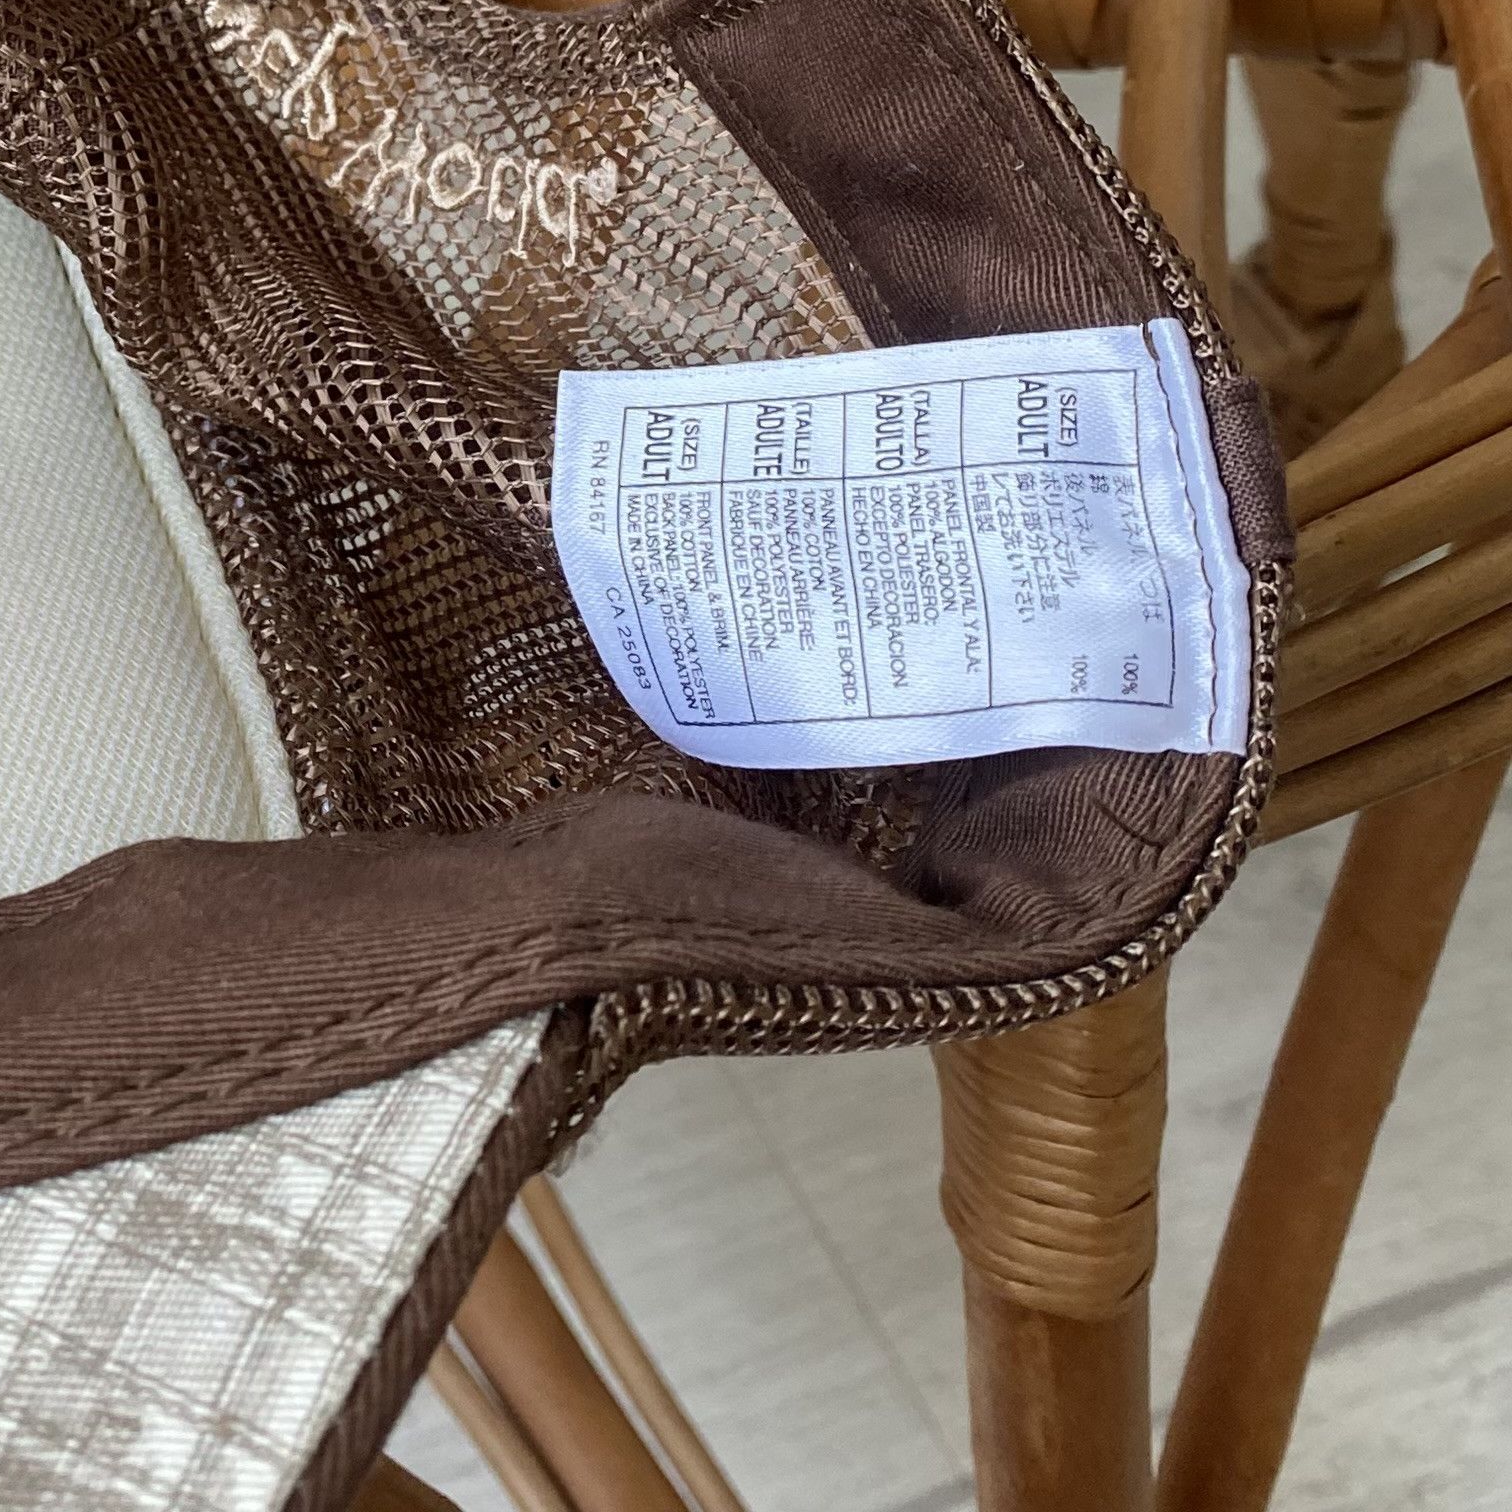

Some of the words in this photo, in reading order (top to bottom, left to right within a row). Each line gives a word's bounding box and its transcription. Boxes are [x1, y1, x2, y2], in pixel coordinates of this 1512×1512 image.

[642, 410, 674, 482] ADULT
[676, 418, 702, 471] (SIZE)
[754, 404, 785, 477] ADULTE
[790, 402, 812, 475] (TAILLE)
[875, 393, 904, 471] ADULTO
[911, 390, 932, 466] (TALLA)
[1018, 379, 1048, 457] ADULT
[1056, 388, 1078, 446] (SIZE)
[590, 440, 610, 469] RN
[589, 477, 607, 536] 84167
[627, 494, 642, 533] MADE
[661, 492, 677, 530] BACK
[679, 491, 694, 527] 100%
[695, 491, 712, 541] FRONT
[728, 490, 748, 571] FABRIQUE
[746, 489, 763, 532] SAUF
[764, 490, 781, 529] 100%
[783, 489, 803, 564] PANNEAU
[801, 489, 818, 529] 100%
[820, 488, 841, 562] PANNEAU
[851, 487, 871, 546] HECHO
[869, 486, 893, 565] EXCEPTO
[888, 485, 906, 528] 100%
[906, 483, 926, 539] PANEL
[923, 481, 941, 527] 100%
[941, 479, 963, 536] PANEL
[968, 473, 997, 535] 中国製
[630, 536, 645, 553] IN
[644, 493, 664, 574] EXCLUSIVE
[664, 531, 681, 581] PANEL:
[680, 531, 702, 594] COTTON
[804, 533, 827, 591] COTON
[858, 550, 874, 573] EN
[631, 555, 655, 606] CHINA
[655, 576, 669, 602] OF
[701, 541, 719, 592] PANEL
[736, 574, 753, 600] EN
[748, 535, 779, 650] DECORATION
[767, 534, 794, 634] POLYESTER
[827, 564, 850, 618] AVANT
[894, 533, 920, 625] POLIESTER
[913, 540, 940, 627] TRASERO:
[930, 530, 958, 613] ALGODON
[951, 539, 977, 616] FRONTAL
[671, 584, 690, 625] 100%
[709, 592, 723, 604] &
[861, 576, 883, 630] CHINA
[963, 621, 980, 631] Y
[605, 586, 626, 621] CA
[617, 626, 652, 690] 25083
[661, 603, 698, 711] DECORATION
[741, 603, 764, 662] CHINE
[834, 620, 851, 645] ET
[879, 568, 909, 688] DECORACION
[680, 627, 716, 720] POLYESTER
[838, 647, 857, 705] BORD:
[1070, 653, 1088, 694] 100%
[1121, 653, 1139, 696] 100%
